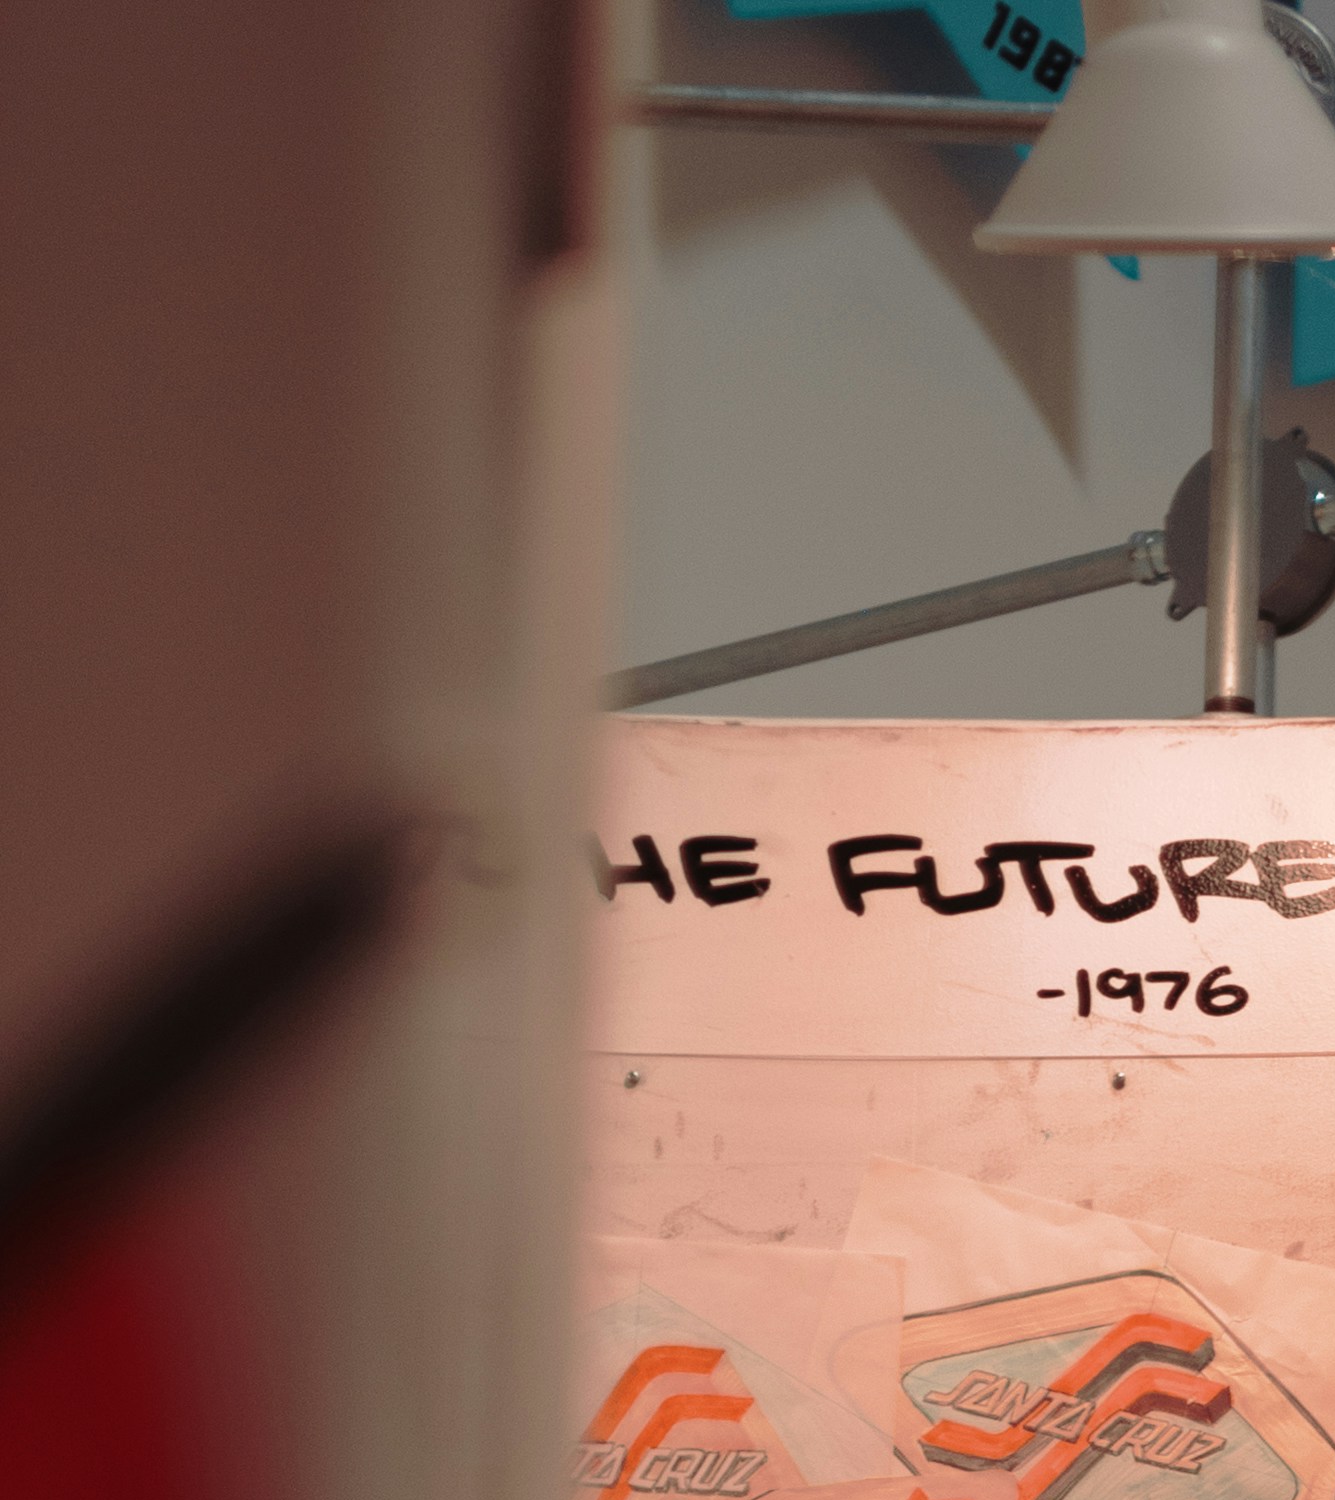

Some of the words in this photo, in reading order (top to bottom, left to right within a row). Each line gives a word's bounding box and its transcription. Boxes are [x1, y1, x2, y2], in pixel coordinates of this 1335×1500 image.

[982, 1, 1083, 94] 198
[592, 835, 771, 907] HE
[1037, 966, 1249, 1018] -1976
[922, 1369, 1096, 1444] SANTA
[1088, 1409, 1227, 1475] CRUZ
[628, 1447, 768, 1498] CRUZ
